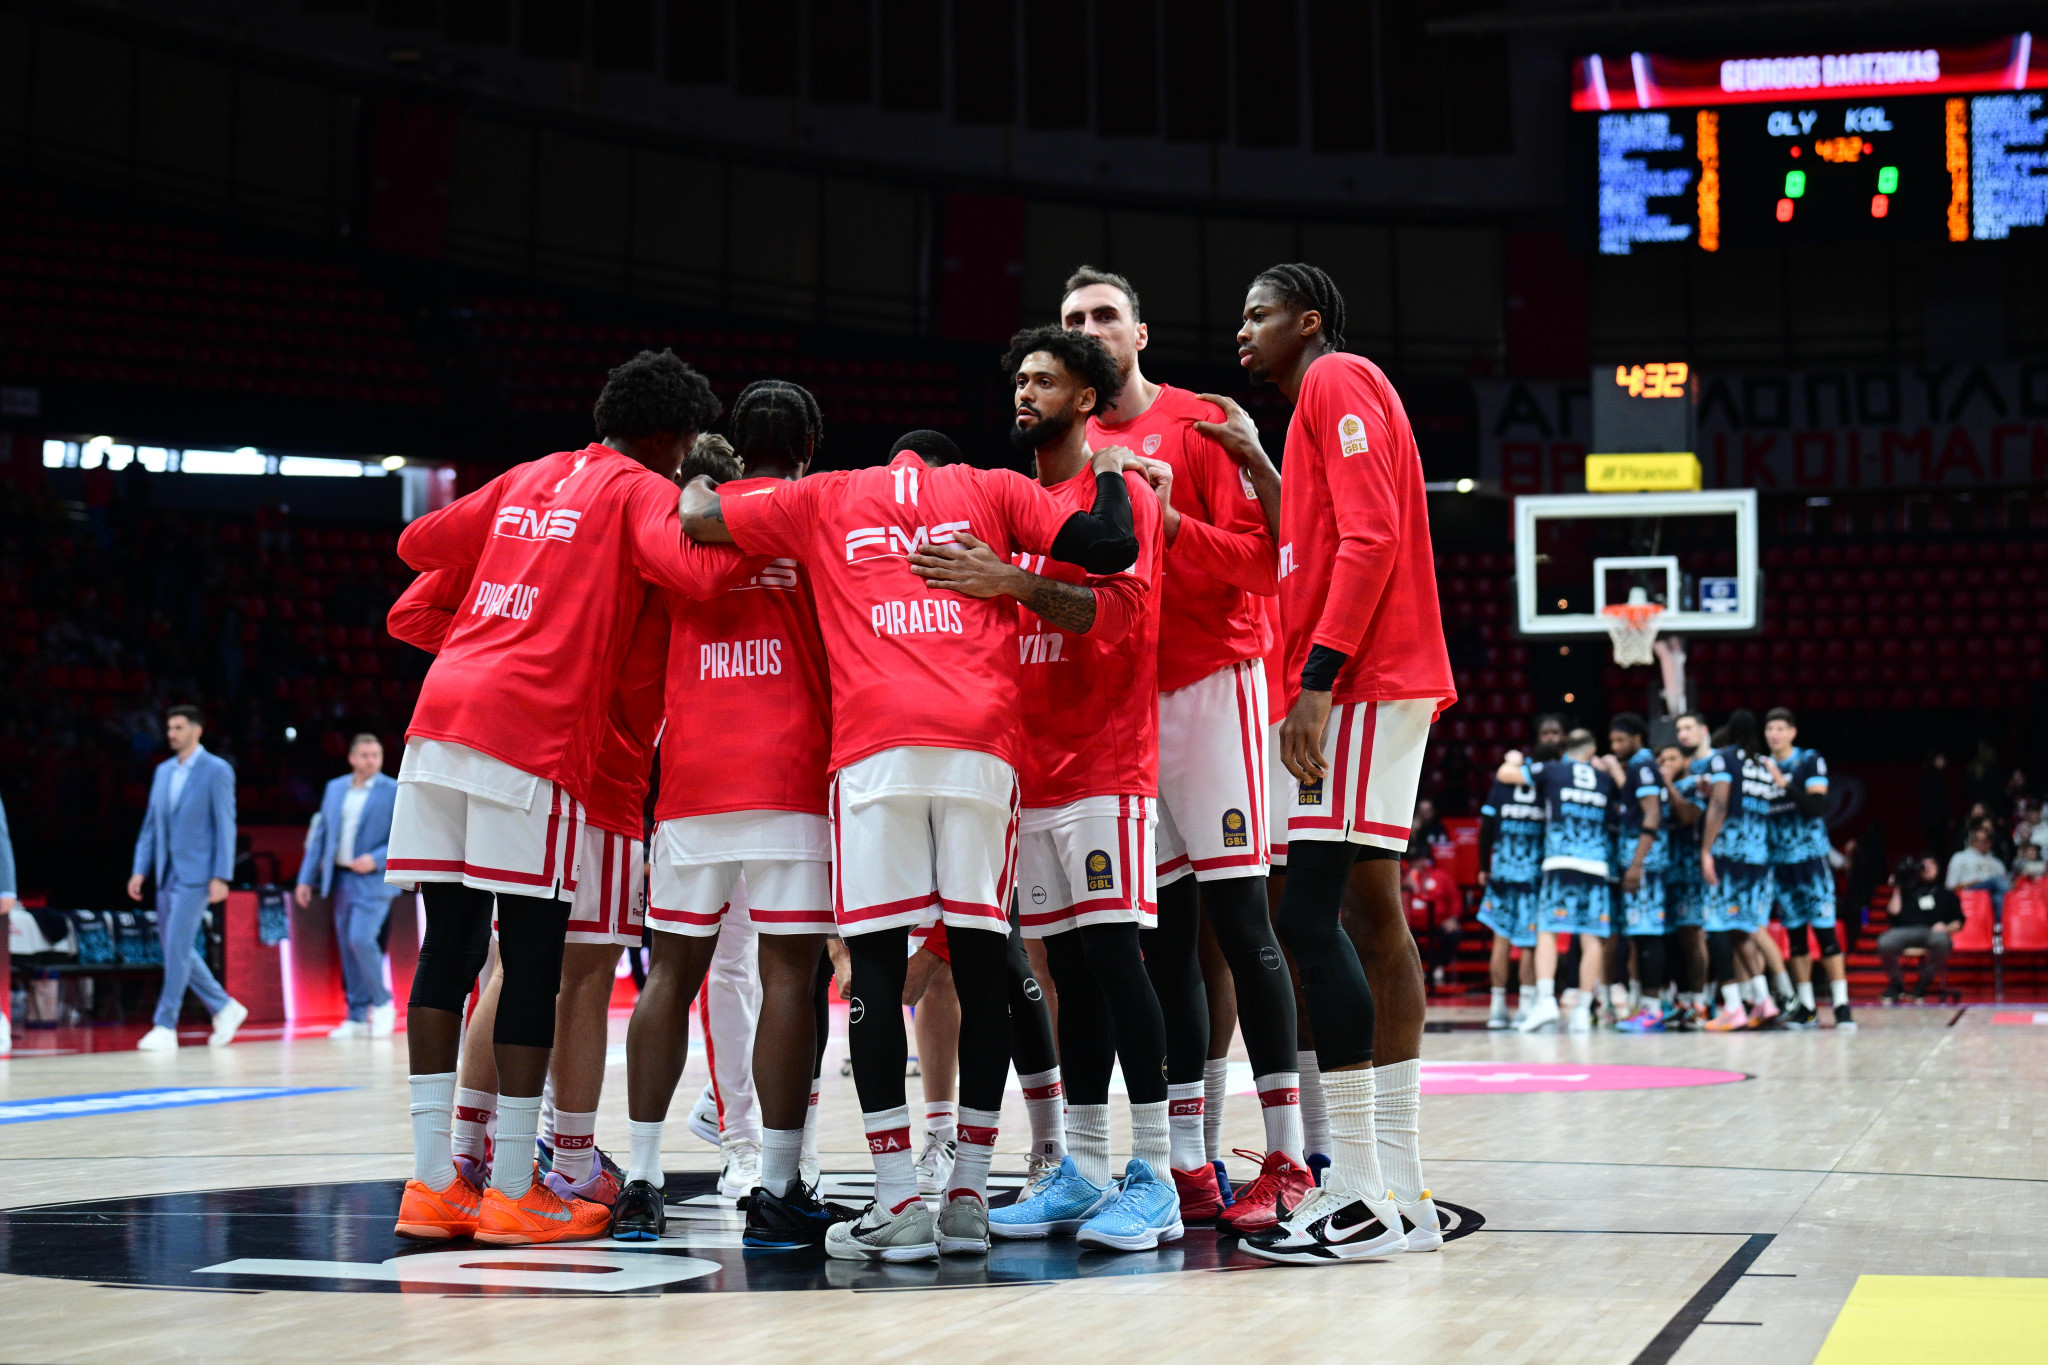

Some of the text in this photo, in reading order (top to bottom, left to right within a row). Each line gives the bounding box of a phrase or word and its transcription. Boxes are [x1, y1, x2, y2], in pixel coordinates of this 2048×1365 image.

[1767, 106, 1893, 136] OLY KOL
[1344, 442, 1367, 454] GBL
[493, 507, 582, 541] FMS
[871, 599, 963, 638] PIRAEUS
[700, 639, 782, 681] PIRAEUS
[1299, 794, 1320, 804] GBL
[1225, 837, 1246, 846] GBL
[1089, 879, 1112, 889] GBL
[560, 1136, 593, 1148] GSA
